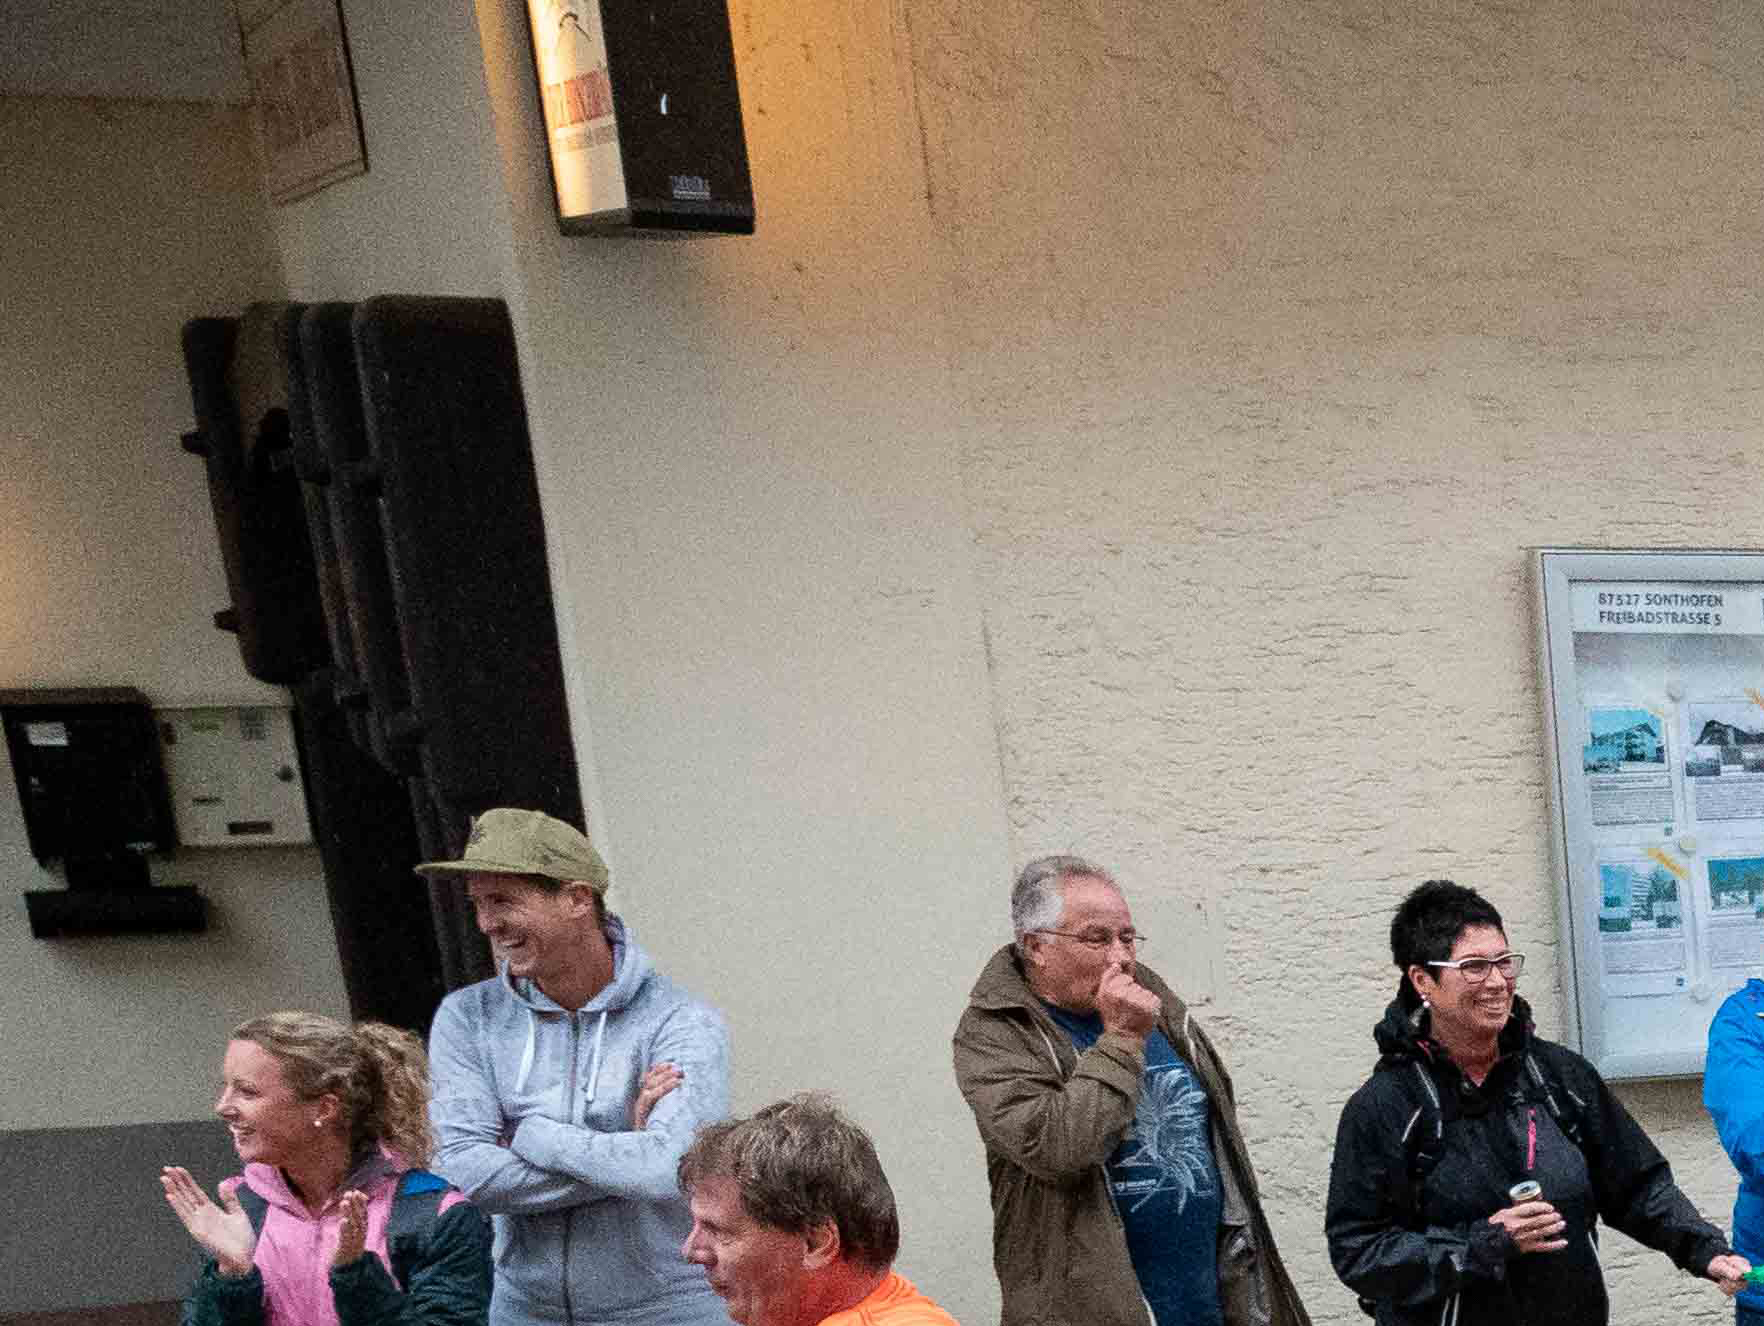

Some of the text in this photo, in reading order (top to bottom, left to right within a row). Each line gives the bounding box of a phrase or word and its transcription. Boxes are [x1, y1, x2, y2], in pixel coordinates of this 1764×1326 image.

[1598, 592, 1724, 608] 87527 SONTHOFEN
[1599, 610, 1712, 625] FREIBADSTRASSE
